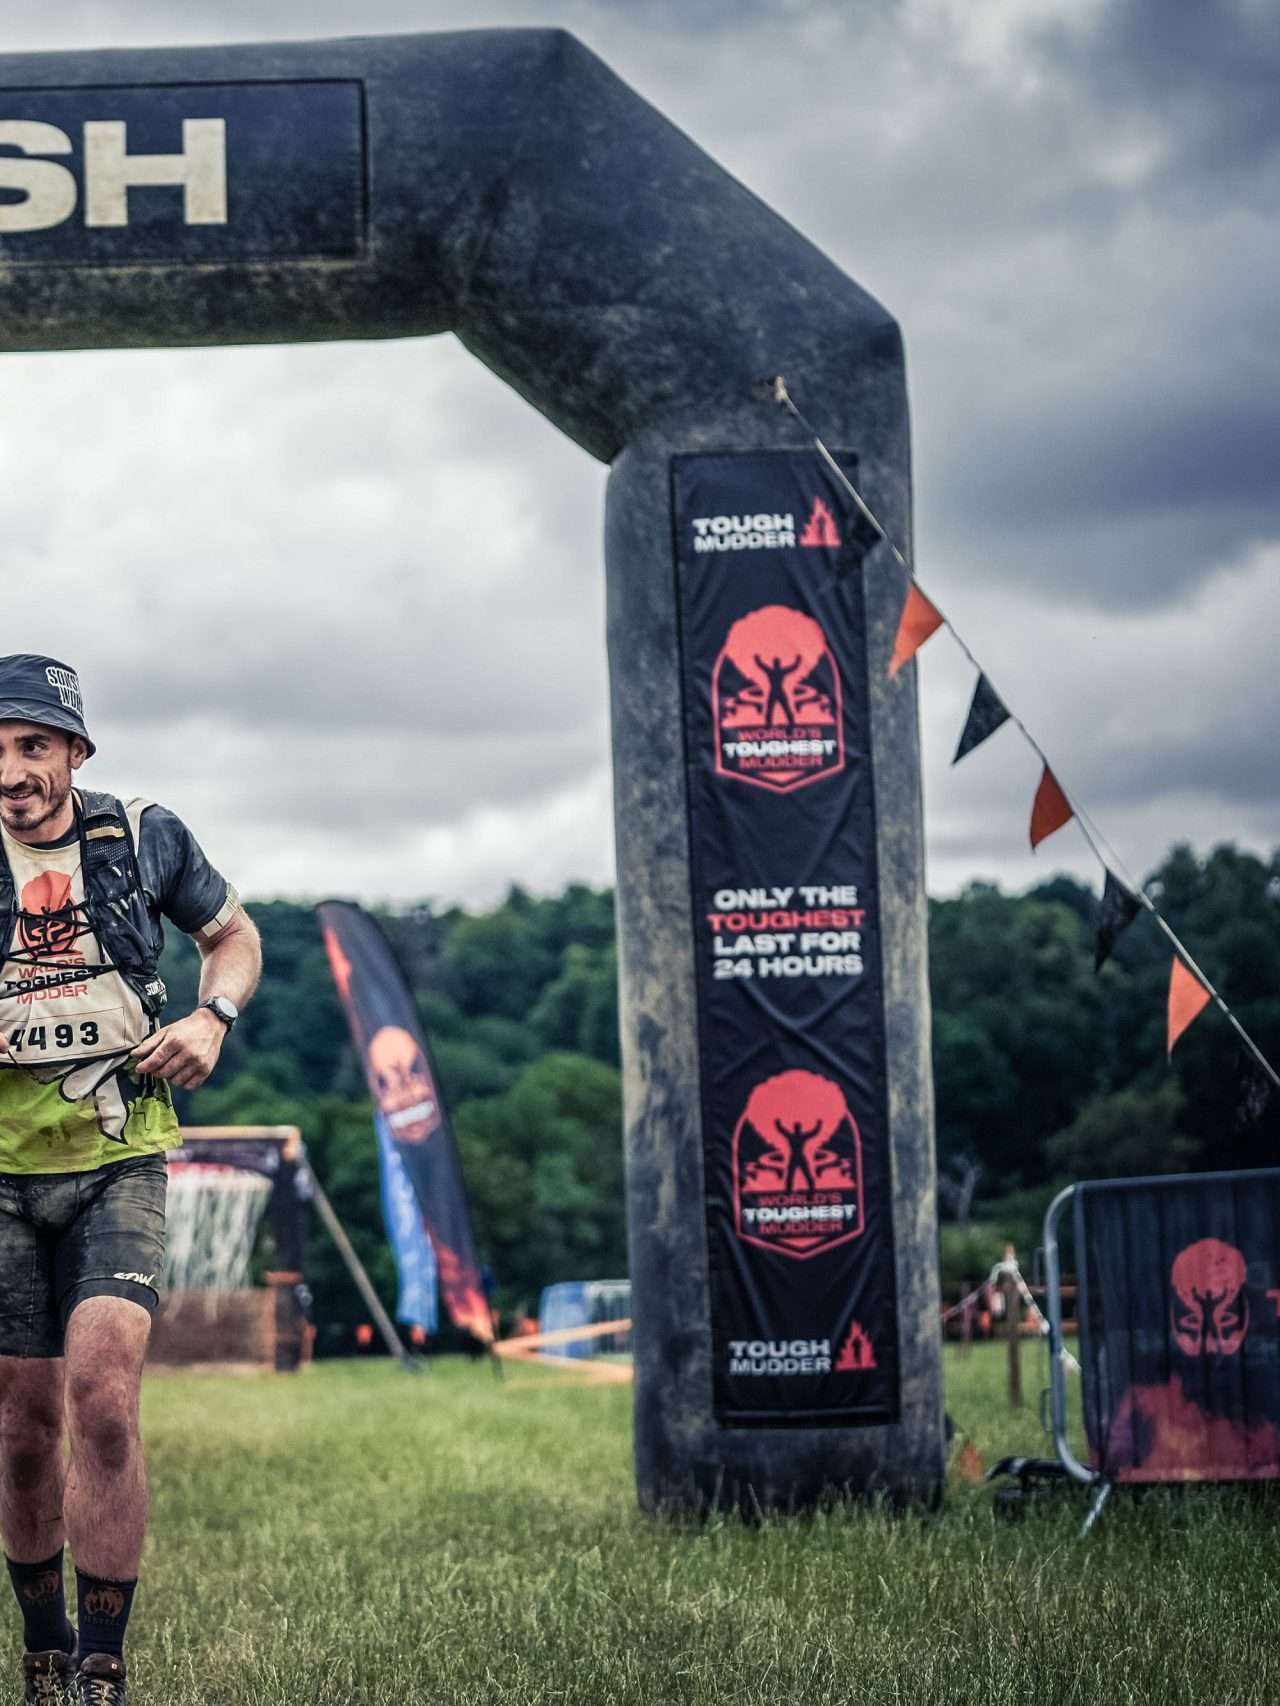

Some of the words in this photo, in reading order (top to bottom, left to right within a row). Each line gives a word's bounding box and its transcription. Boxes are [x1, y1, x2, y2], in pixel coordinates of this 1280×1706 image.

[692, 513, 795, 535] TOUGH
[694, 531, 796, 553] MUDDER
[722, 739, 838, 758] TOUGHEST
[714, 886, 794, 911] ONLY
[798, 885, 858, 906] THE
[706, 908, 865, 932] TOUGHEST
[713, 933, 796, 957] LAST
[800, 931, 861, 953] FOR
[713, 958, 755, 980] 24
[758, 953, 864, 978] HOURS
[10, 1021, 99, 1052] 4493
[742, 1203, 856, 1224] TOUGHEST
[728, 1338, 831, 1358] TOUGH
[729, 1356, 832, 1376] MUDDER
